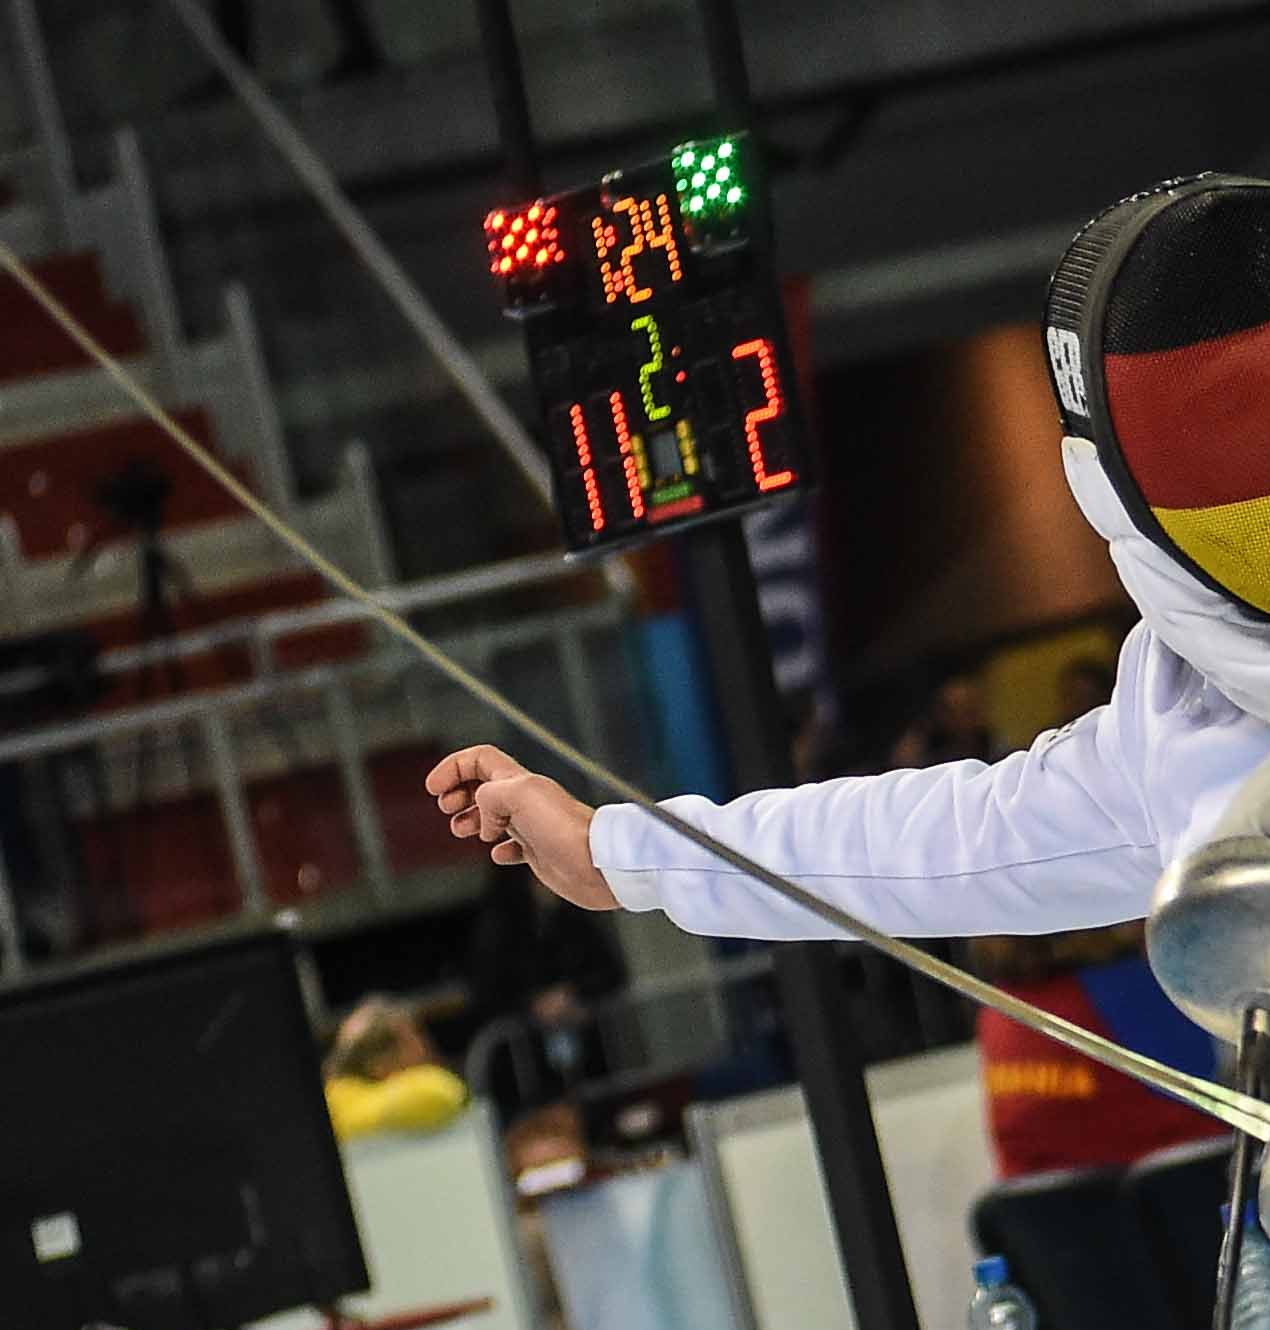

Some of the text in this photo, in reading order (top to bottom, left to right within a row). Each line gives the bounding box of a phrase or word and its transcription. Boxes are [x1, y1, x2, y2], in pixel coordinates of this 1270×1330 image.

[630, 314, 671, 421] 2
[731, 338, 797, 491] 2
[569, 391, 646, 532] 11
